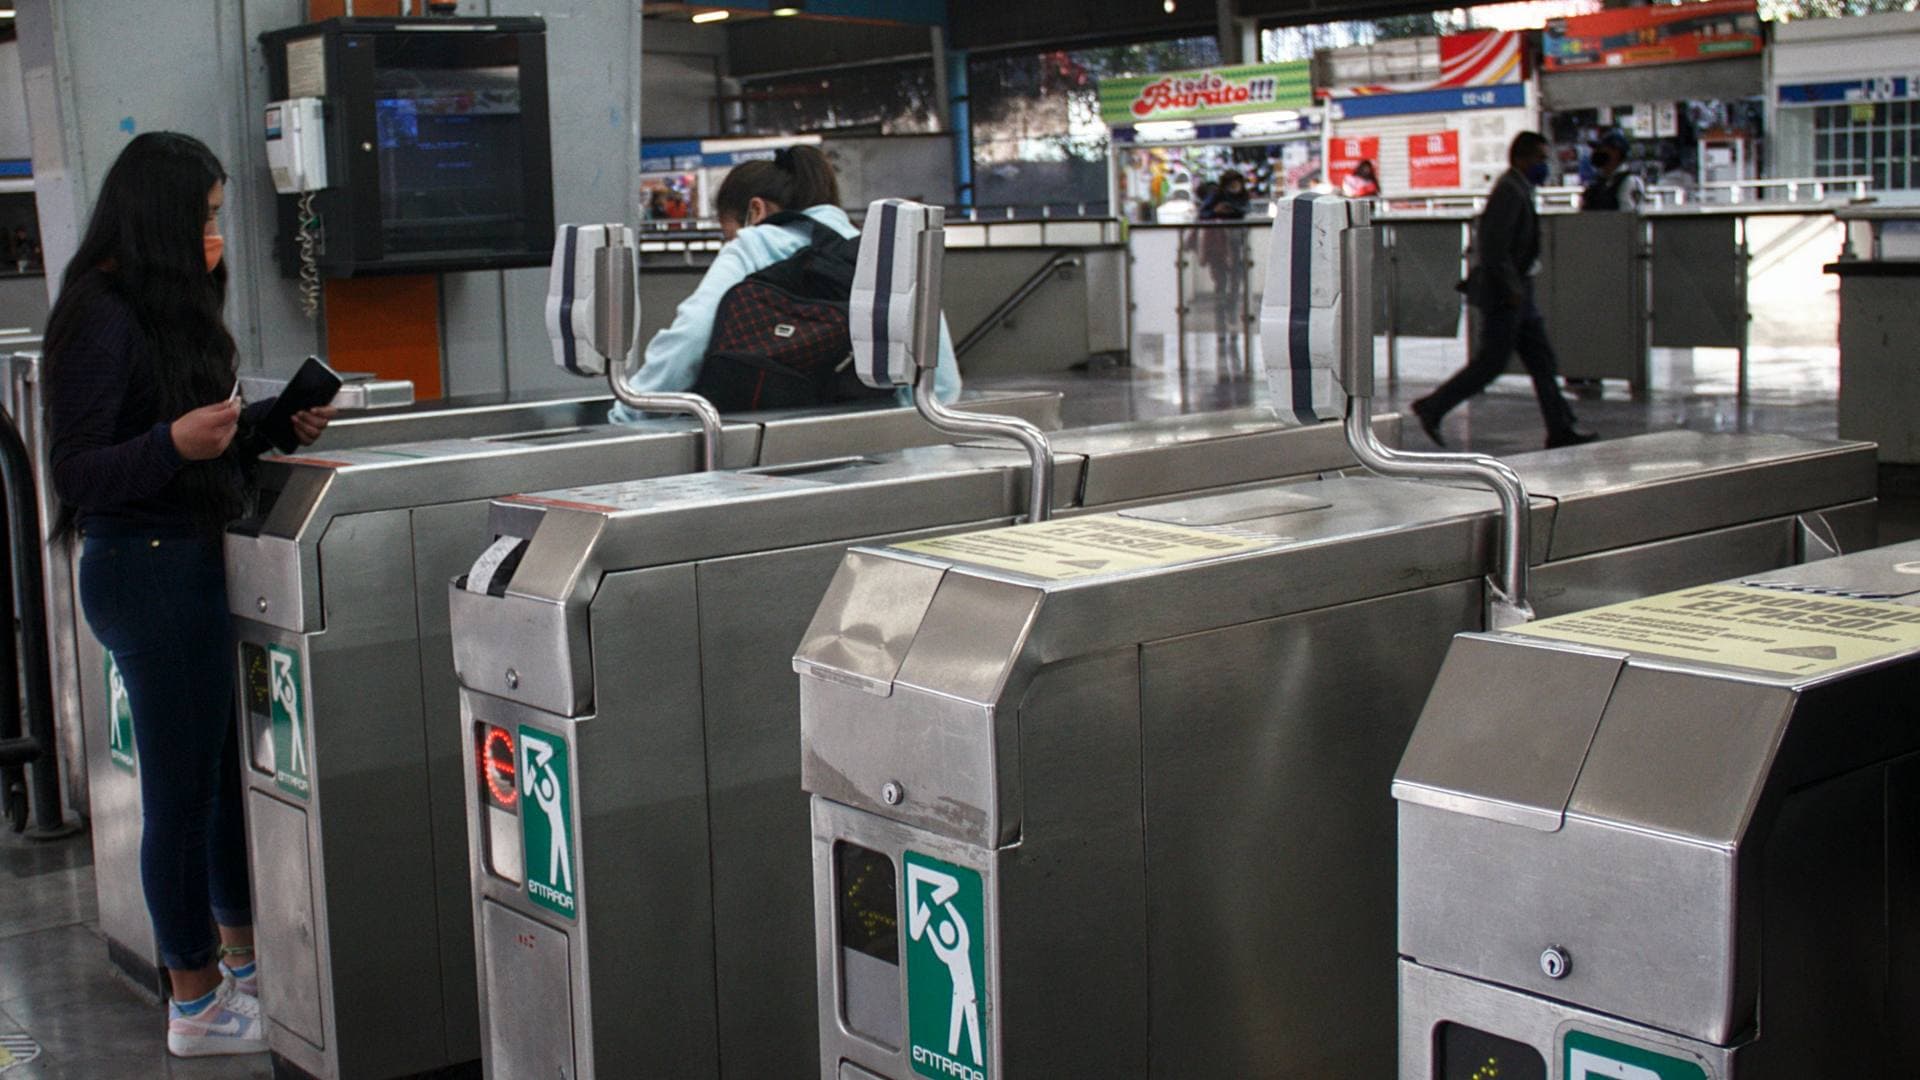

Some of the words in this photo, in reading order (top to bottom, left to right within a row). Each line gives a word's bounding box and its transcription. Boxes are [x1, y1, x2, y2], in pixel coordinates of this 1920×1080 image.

[1132, 78, 1275, 116] Barato!!!
[1677, 600, 1737, 613] EL
[1734, 607, 1899, 632] PASO!
[528, 879, 574, 911] ENTRADA
[912, 1044, 985, 1080] ENTRADA
